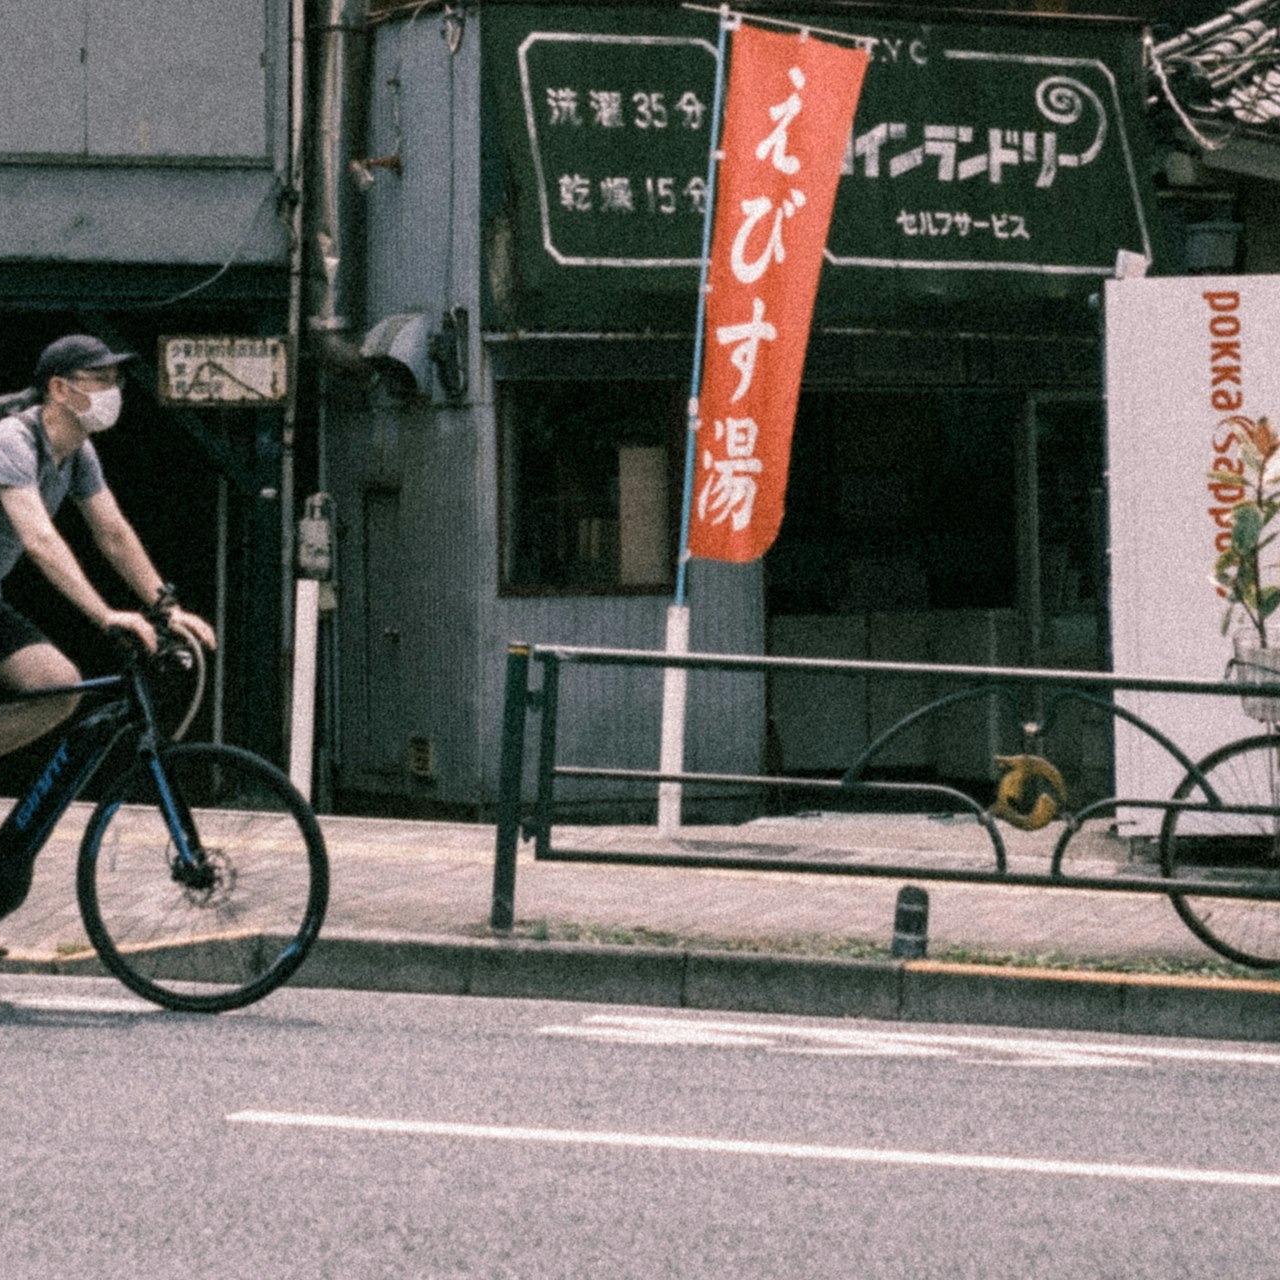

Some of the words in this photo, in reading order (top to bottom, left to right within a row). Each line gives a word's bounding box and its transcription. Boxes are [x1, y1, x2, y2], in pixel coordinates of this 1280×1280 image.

[896, 209, 1031, 239] セルフサービス
[698, 66, 807, 532] えびす湯
[1202, 290, 1243, 410] pokka
